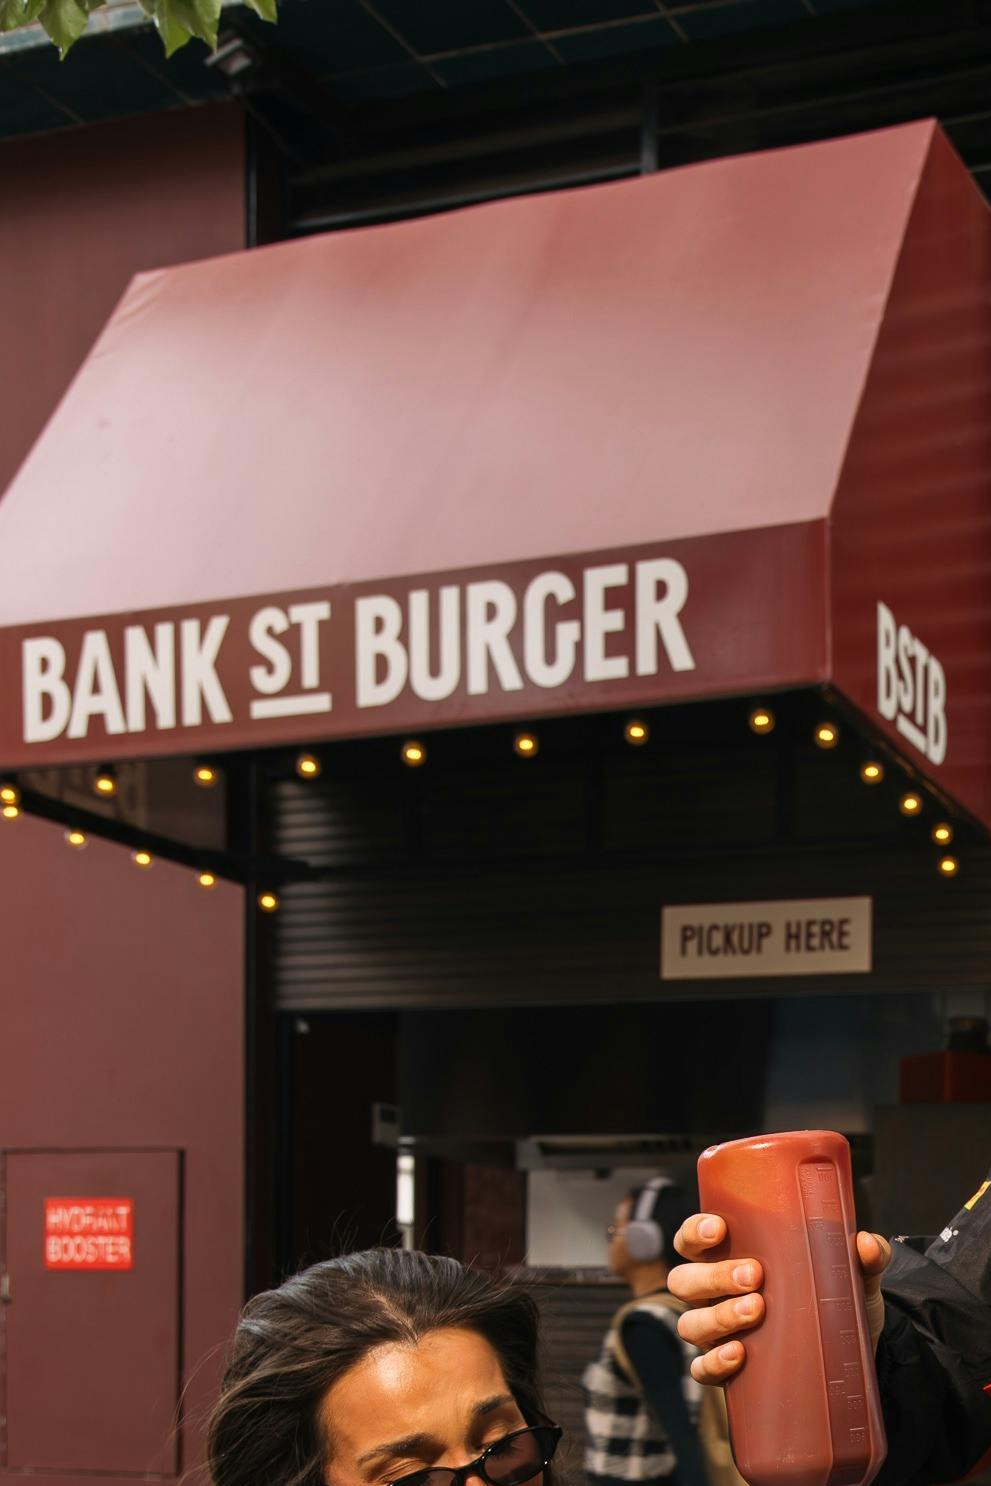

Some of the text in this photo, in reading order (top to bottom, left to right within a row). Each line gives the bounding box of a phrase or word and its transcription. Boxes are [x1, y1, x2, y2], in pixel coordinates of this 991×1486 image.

[23, 557, 696, 743] BANK ST BURGER
[877, 600, 948, 766] BSTB
[680, 917, 852, 958] PICKUP HERE
[46, 1235, 131, 1264] BOOSTER
